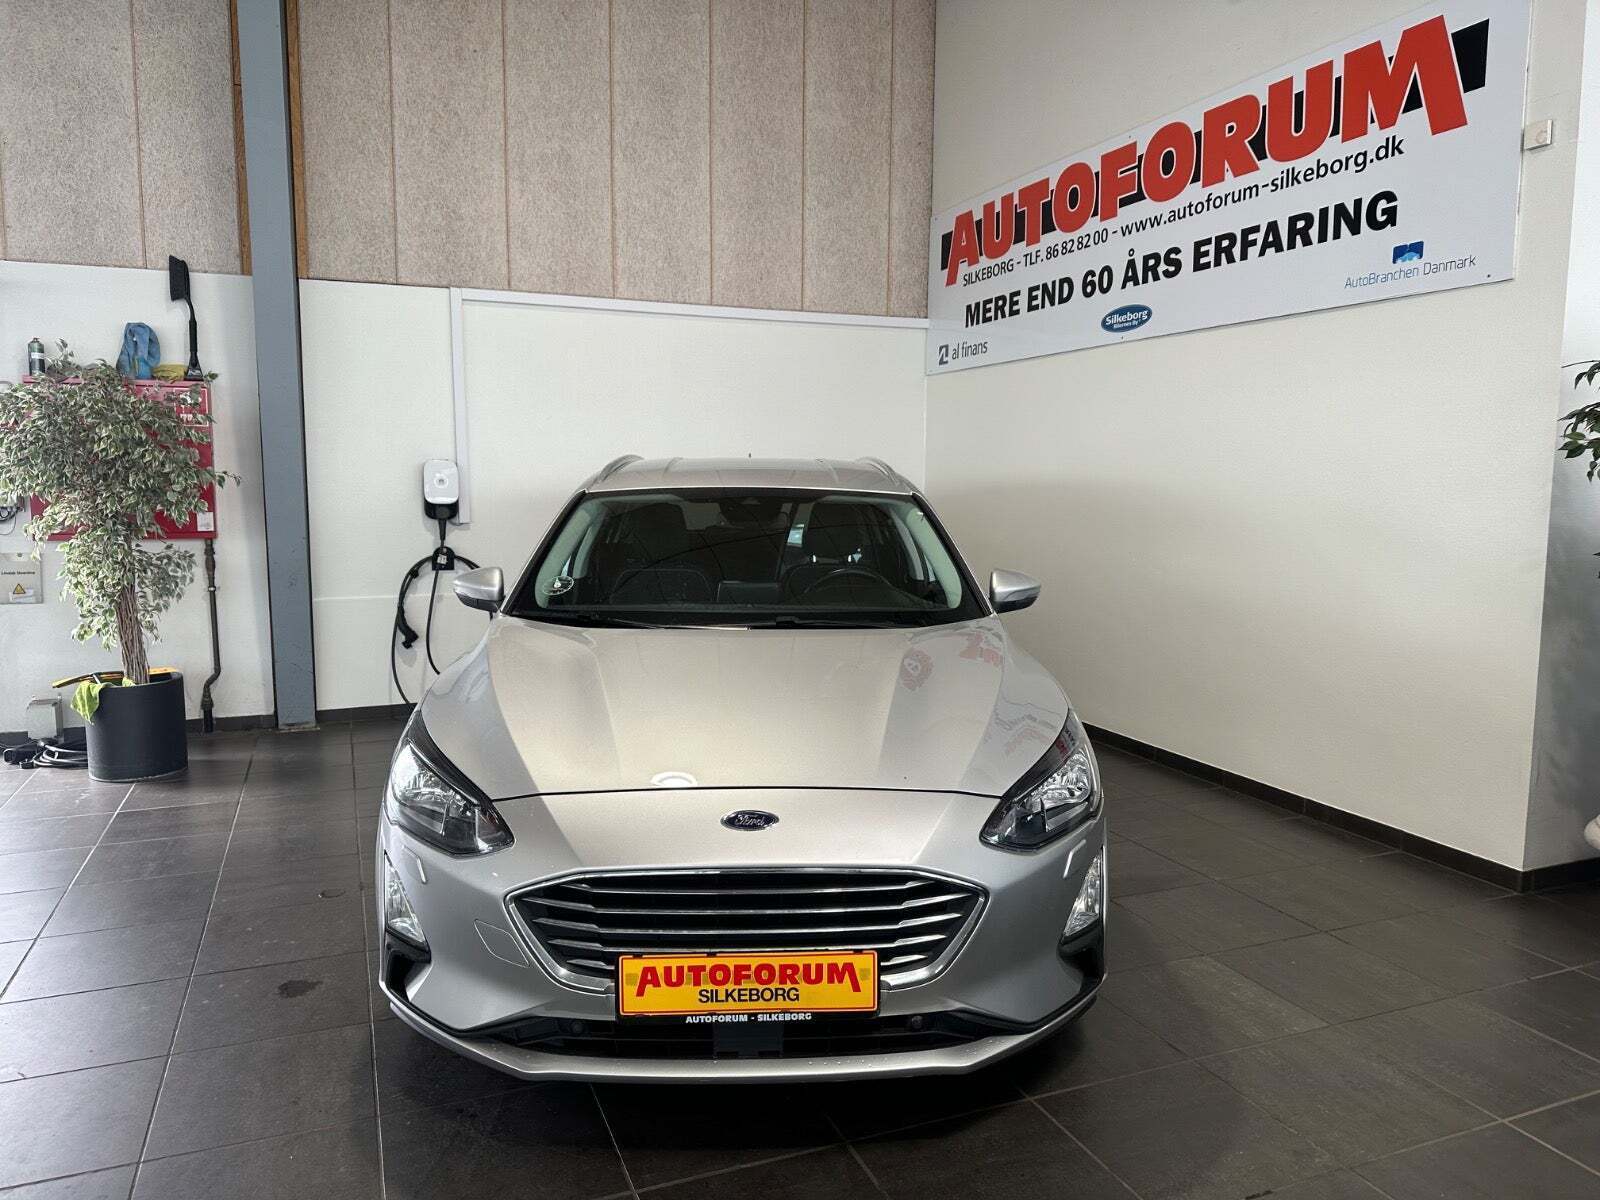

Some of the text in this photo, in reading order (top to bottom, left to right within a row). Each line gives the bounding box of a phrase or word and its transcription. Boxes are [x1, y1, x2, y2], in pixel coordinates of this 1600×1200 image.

[945, 14, 1468, 287] AUTOFORUM
[963, 259, 1014, 287] SILKEBORG
[1023, 252, 1044, 268] TLF.
[1121, 134, 1405, 237] www.autoforum-silkeborg.dk
[965, 190, 1398, 328] MERE END 60 ÅRS ERFARING
[1344, 254, 1477, 289] AutoBranchen Danmark
[1105, 310, 1148, 325] Silkeborg
[952, 340, 988, 360] al finans
[635, 962, 862, 997] AUTOFORUM
[698, 987, 800, 1004] SILKEBORG
[685, 1014, 748, 1024] AUTOFORUM
[757, 1012, 812, 1022] SILKEBORG
